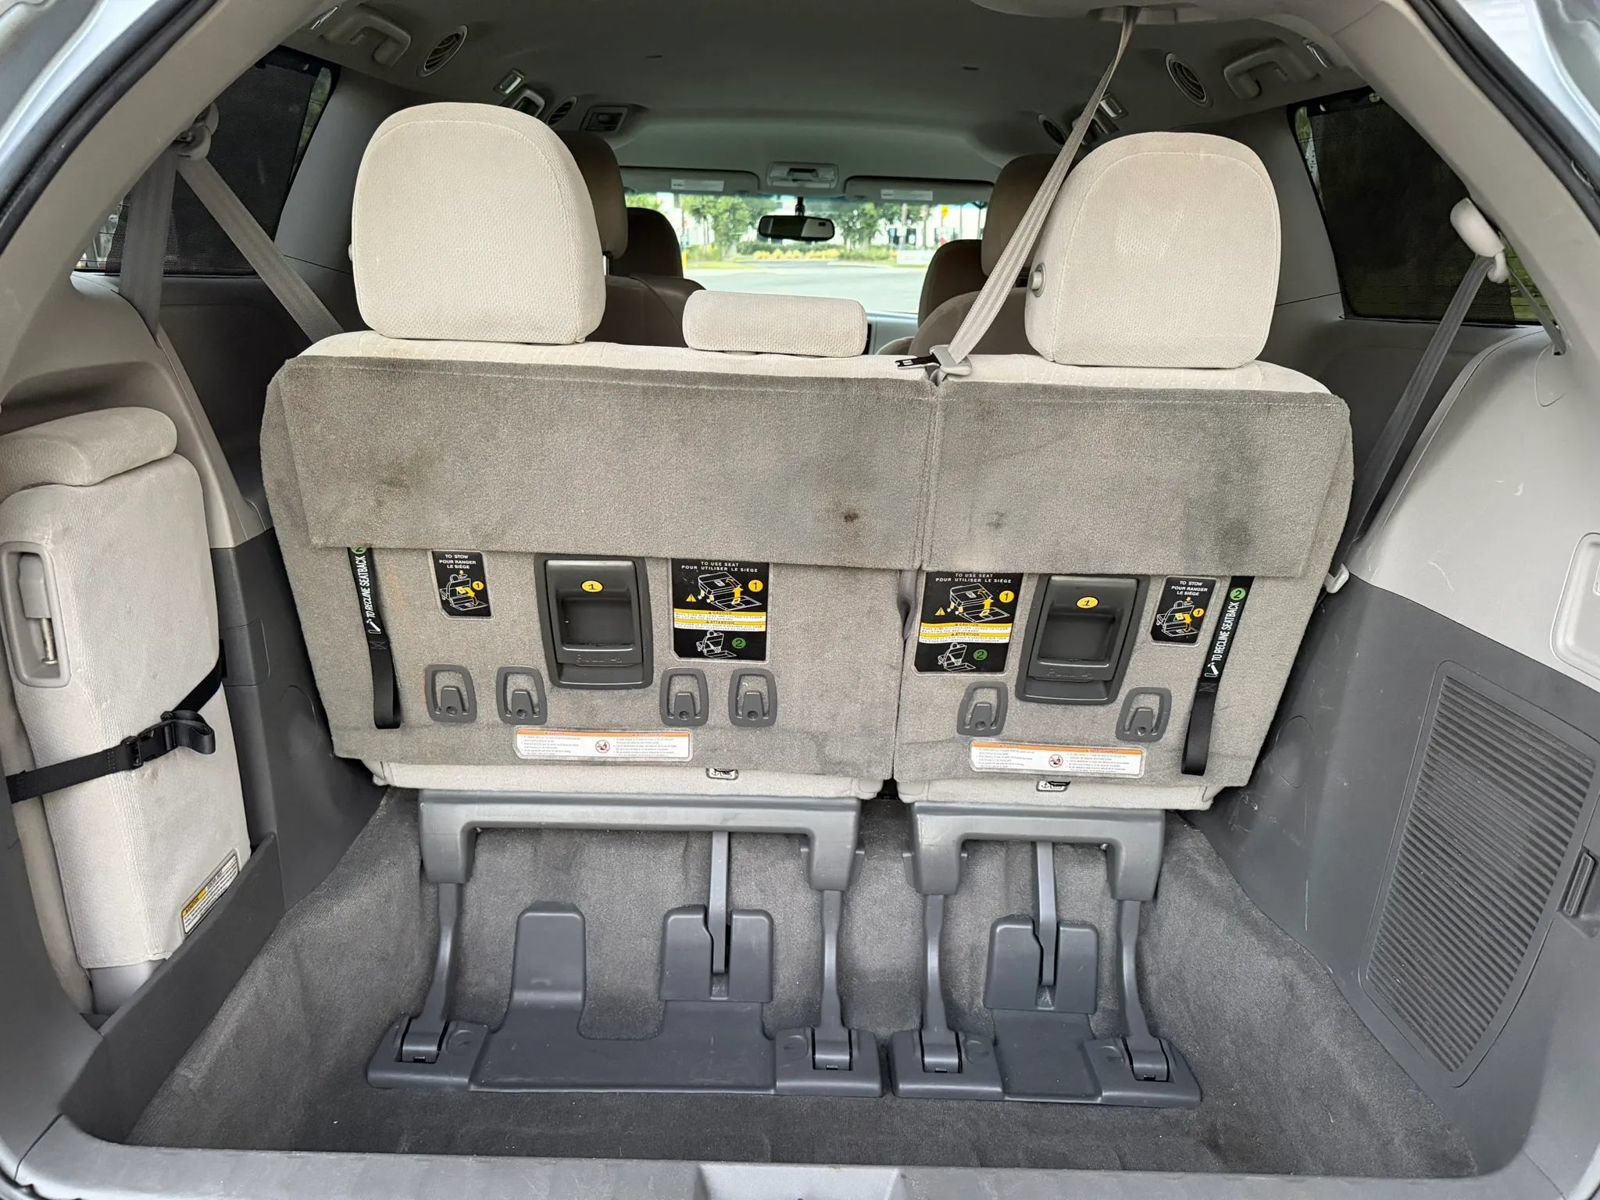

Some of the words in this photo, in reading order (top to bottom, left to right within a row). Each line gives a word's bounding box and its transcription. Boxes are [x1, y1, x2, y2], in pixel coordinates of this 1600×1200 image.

[355, 556, 370, 587] SEATBACK
[1221, 602, 1240, 630] SEATBACK
[1214, 630, 1230, 654] RECLINE
